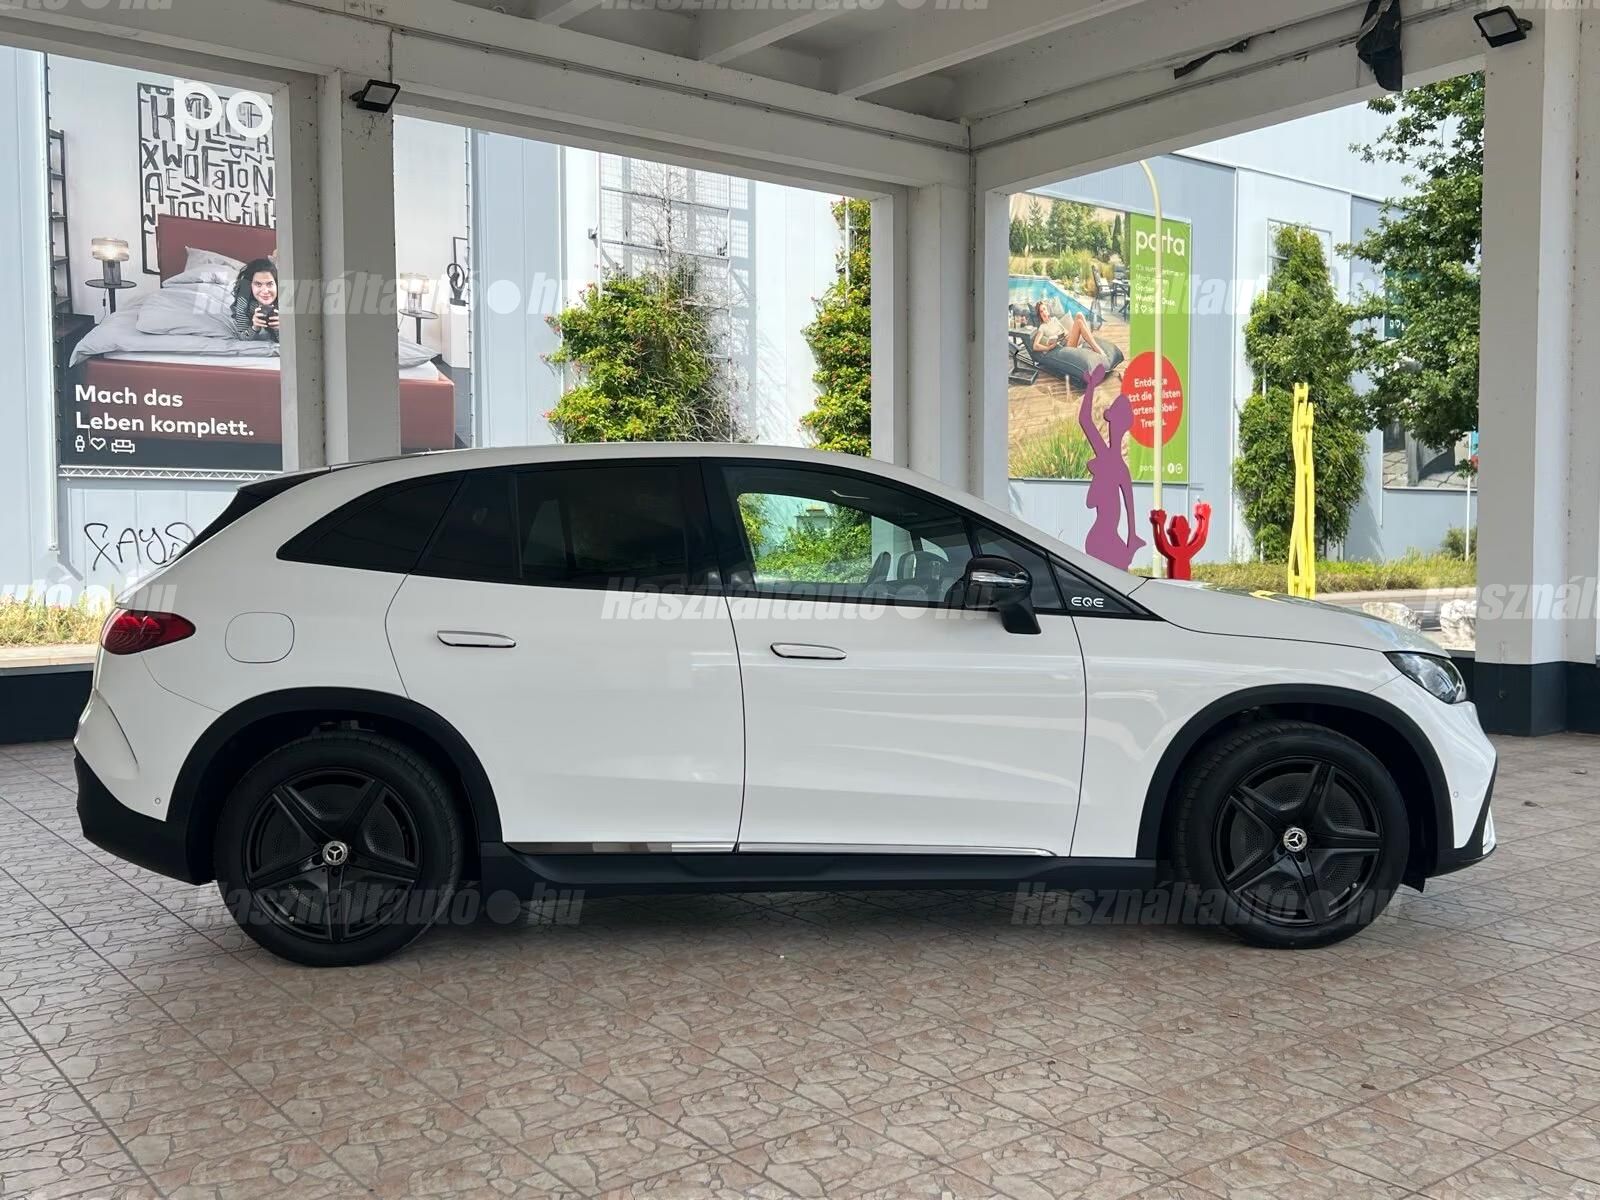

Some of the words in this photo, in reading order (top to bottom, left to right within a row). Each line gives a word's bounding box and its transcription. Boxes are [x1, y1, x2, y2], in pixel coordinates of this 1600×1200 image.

[75, 384, 138, 404] Mach
[144, 389, 183, 408] das
[76, 412, 144, 431] Leben
[151, 415, 254, 438] komplett.
[1071, 596, 1104, 608] EQE
